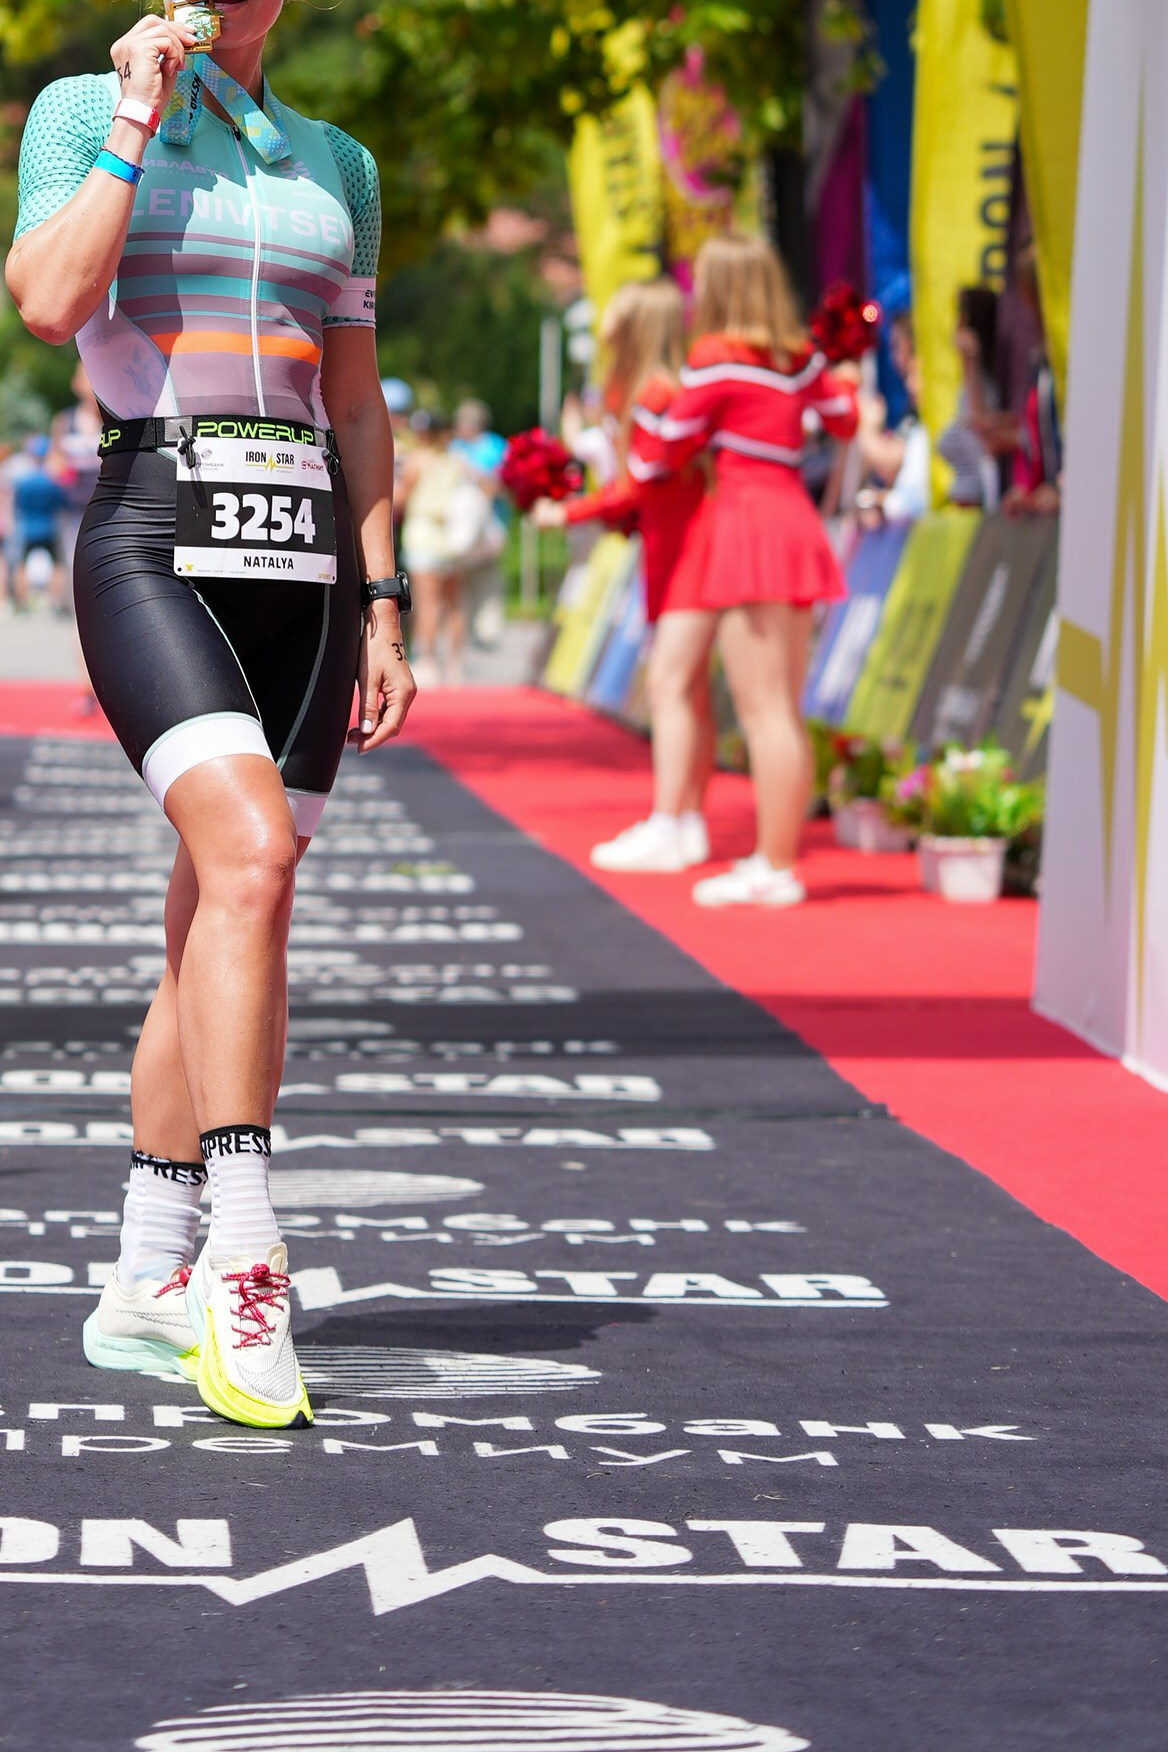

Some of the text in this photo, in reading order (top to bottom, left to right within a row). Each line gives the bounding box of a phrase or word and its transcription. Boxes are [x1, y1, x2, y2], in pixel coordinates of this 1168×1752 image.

[245, 451, 295, 465] IRON STAR
[210, 493, 316, 544] 3254
[243, 555, 295, 570] NATALYA
[335, 1073, 662, 1098] STAR
[354, 1127, 716, 1148] STAR
[428, 1267, 886, 1299] STAR
[542, 1517, 1168, 1575] STAR
